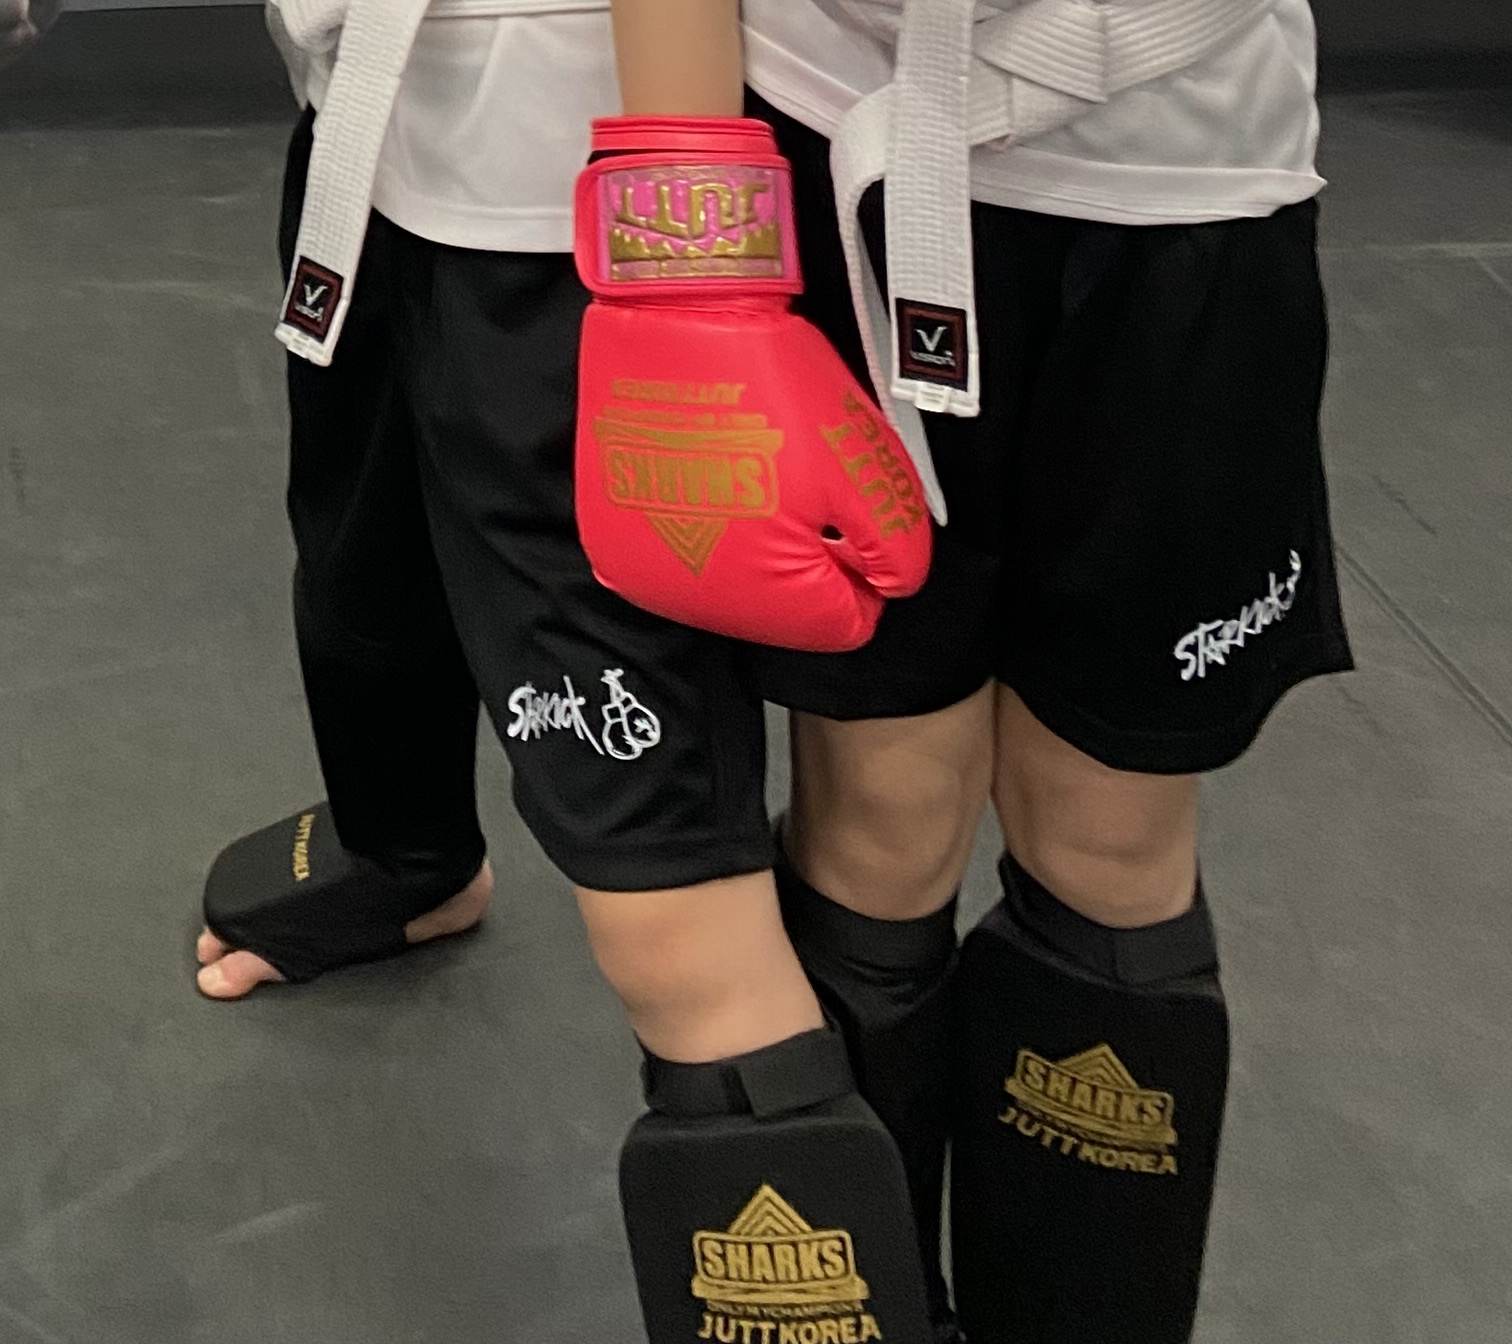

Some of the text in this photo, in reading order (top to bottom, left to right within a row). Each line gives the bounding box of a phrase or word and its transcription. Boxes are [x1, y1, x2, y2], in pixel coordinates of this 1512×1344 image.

[611, 452, 767, 509] SHARKS
[1021, 1059, 1168, 1126] SHARKS
[702, 1238, 848, 1282] SHARKS
